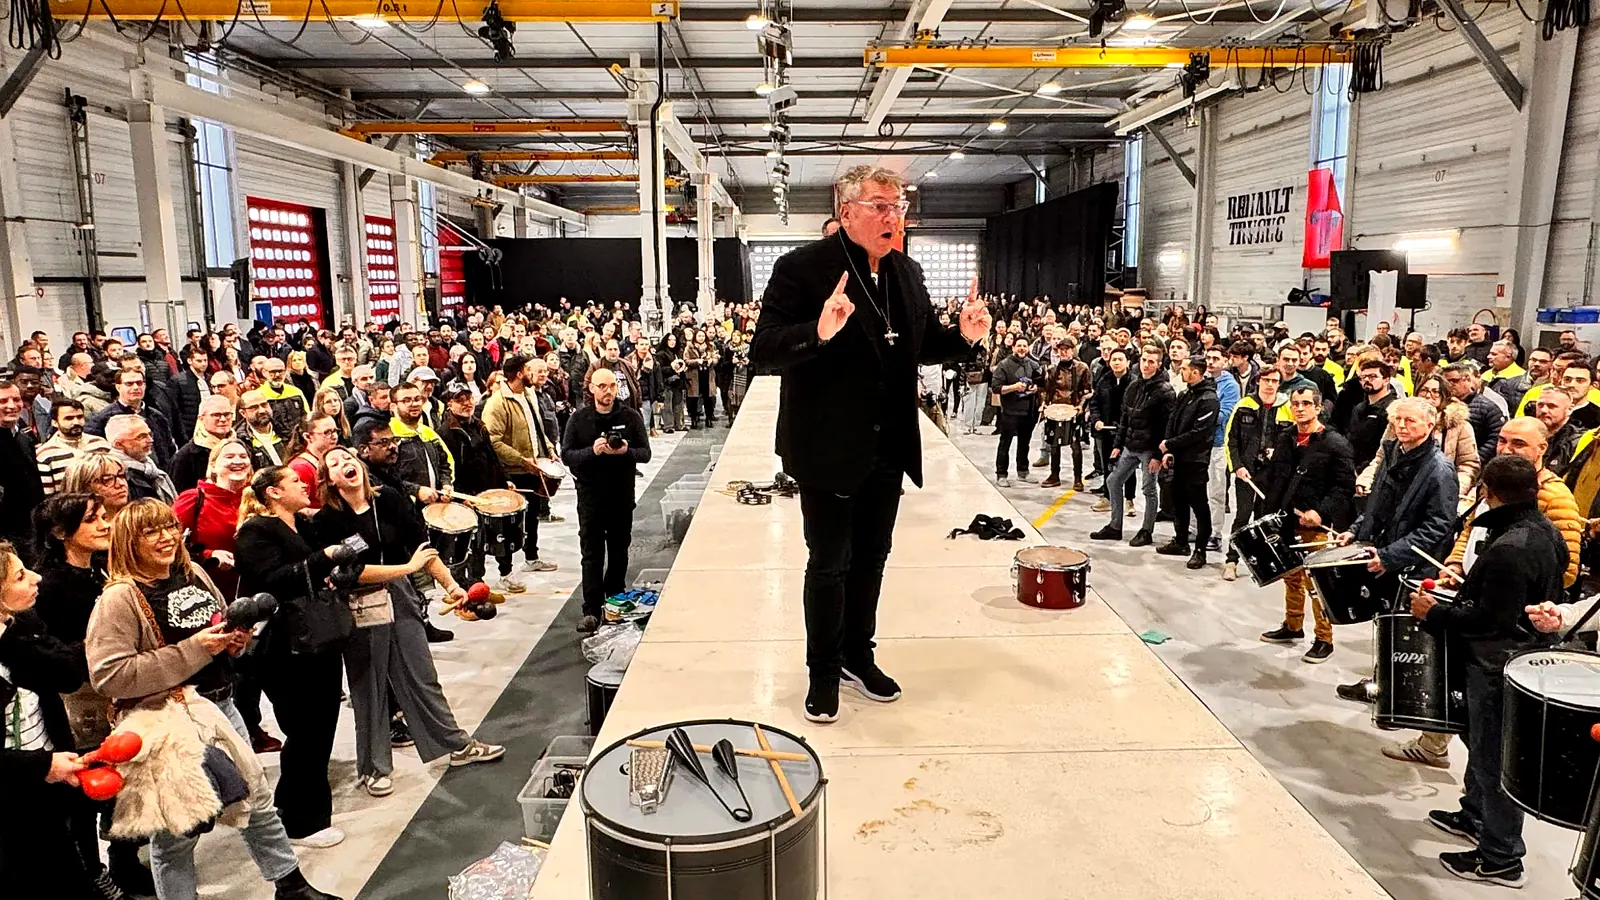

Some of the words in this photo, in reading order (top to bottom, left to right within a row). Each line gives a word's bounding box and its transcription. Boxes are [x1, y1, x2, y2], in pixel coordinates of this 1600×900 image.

[383, 3, 400, 12] 0.5
[94, 172, 105, 185] 07
[1435, 169, 1446, 182] 07
[1391, 651, 1429, 665] GOPE
